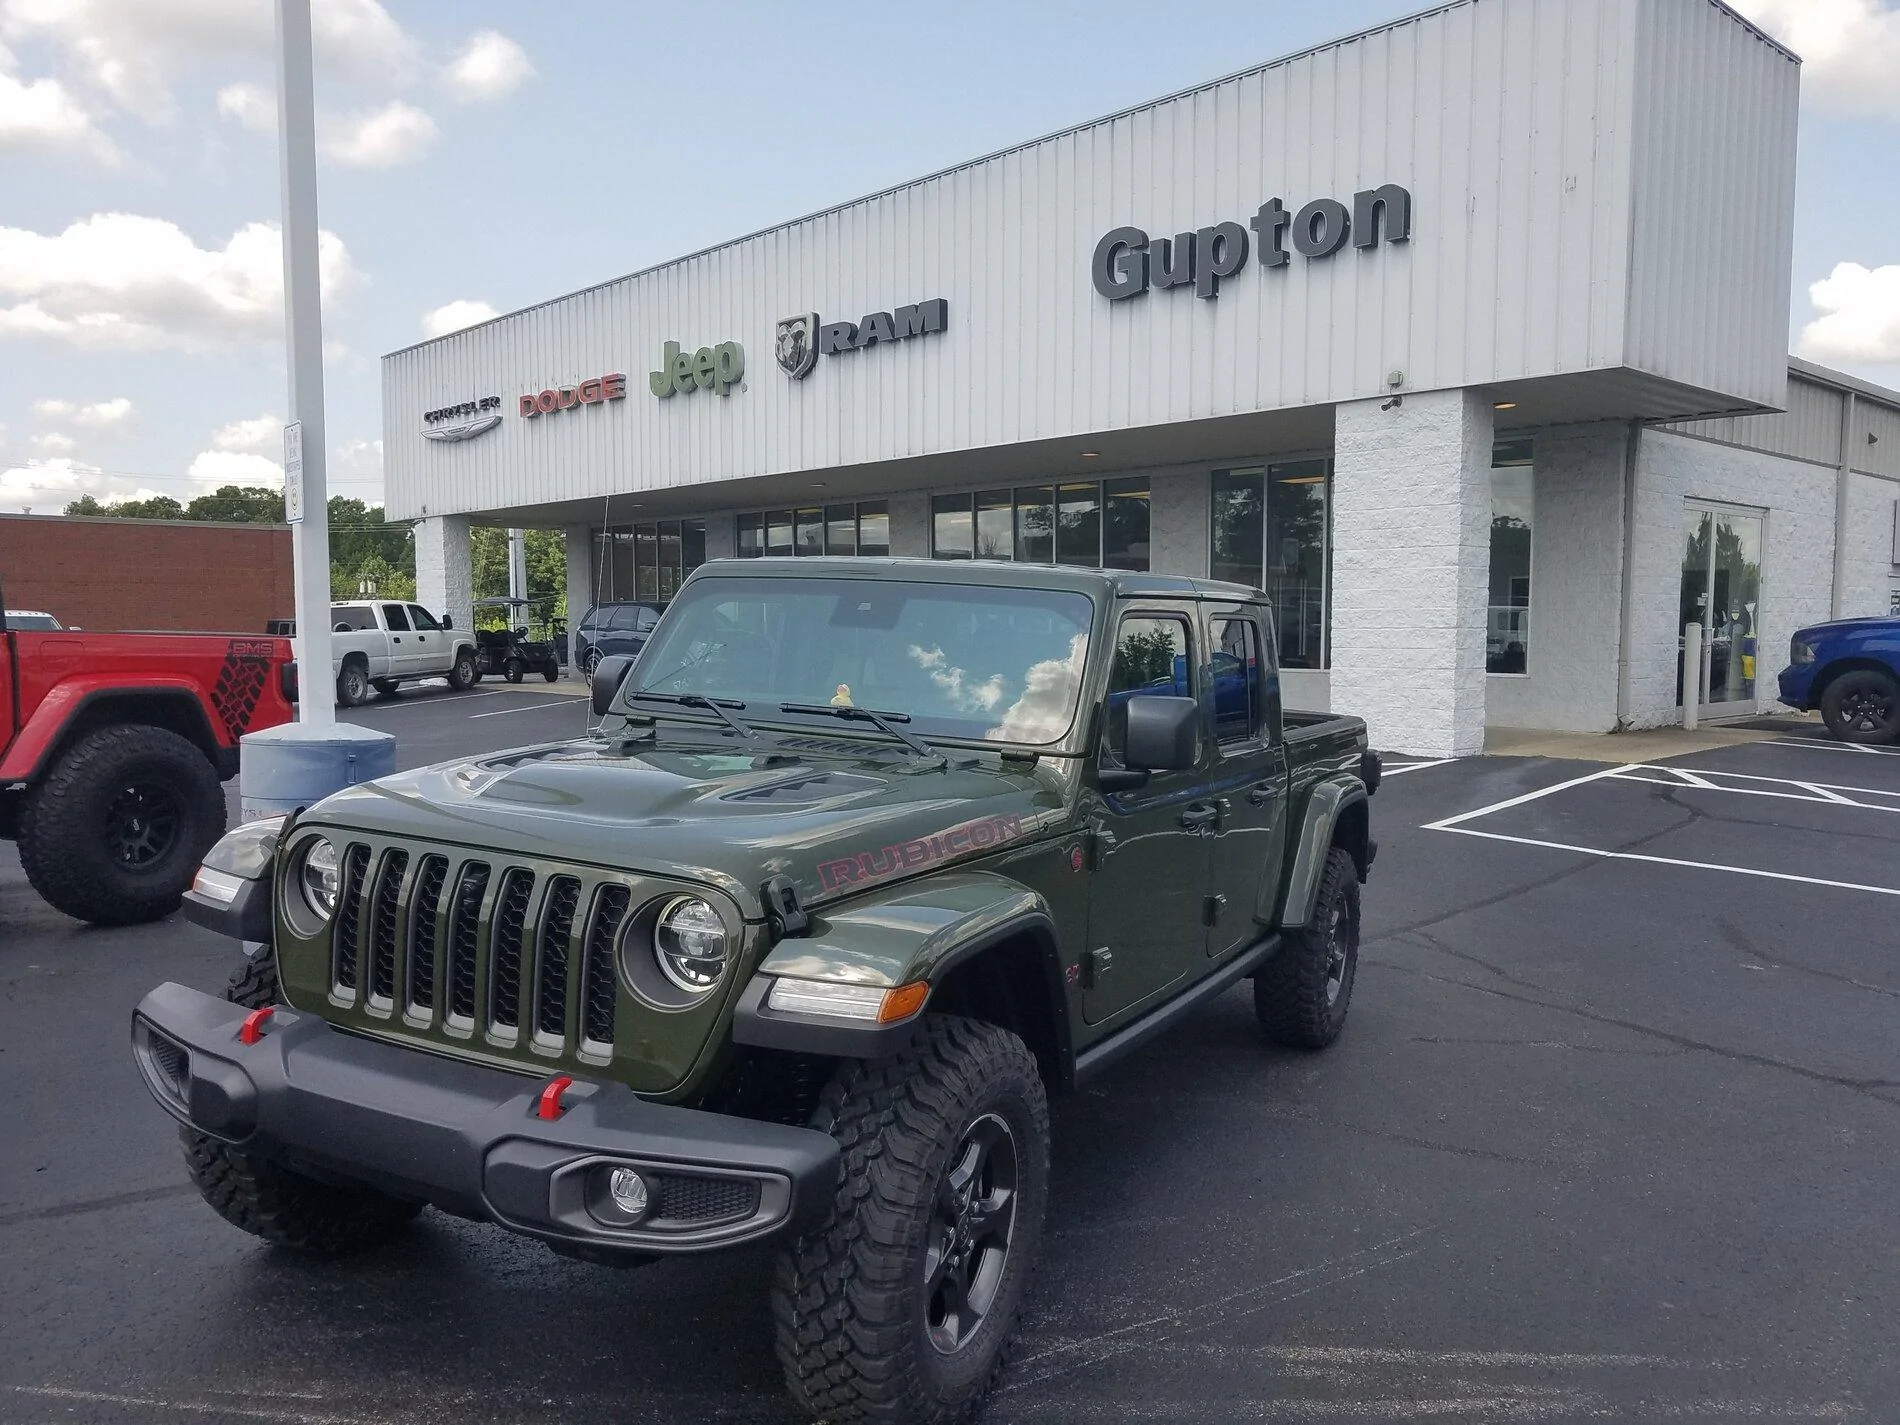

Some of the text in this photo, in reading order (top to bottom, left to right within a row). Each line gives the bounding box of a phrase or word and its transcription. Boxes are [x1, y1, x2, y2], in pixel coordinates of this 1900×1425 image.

[1091, 182, 1412, 300] Gupton
[820, 297, 949, 356] RAM
[519, 372, 627, 419] DODGE
[648, 340, 745, 397] Jeep
[424, 396, 501, 423] CHRYSLER
[816, 812, 1023, 892] RUBICON
